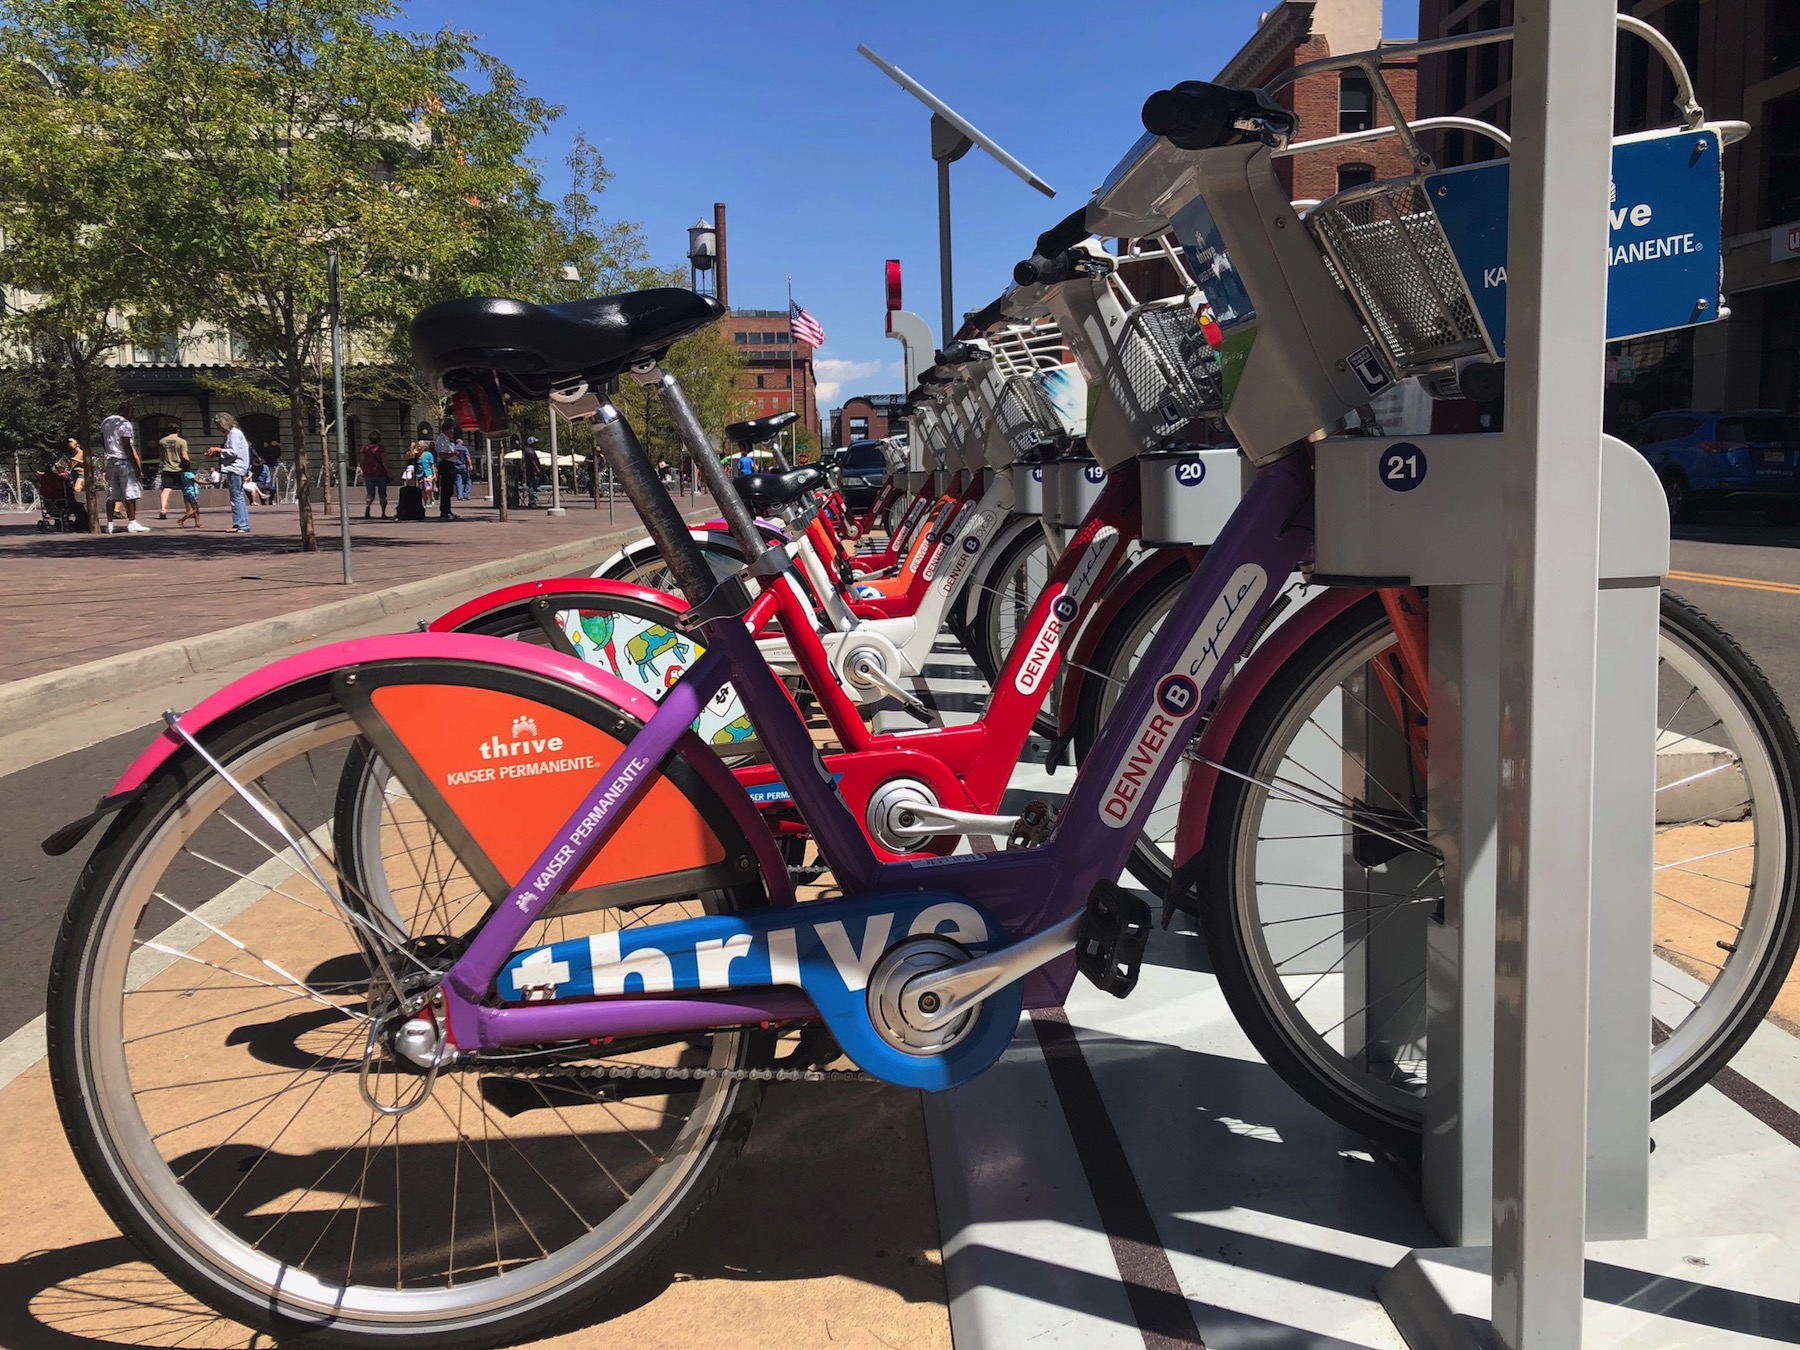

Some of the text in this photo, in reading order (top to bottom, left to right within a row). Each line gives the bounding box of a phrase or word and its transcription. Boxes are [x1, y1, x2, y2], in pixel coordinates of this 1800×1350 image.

[1609, 233, 1695, 266] ANENTE
[1087, 466, 1104, 479] 19
[1179, 462, 1202, 480] 20
[1387, 455, 1417, 480] 21
[911, 542, 931, 571] DENVER
[925, 544, 947, 578] DENVER
[943, 553, 970, 593] DENVER
[1020, 620, 1063, 688] DENVER
[1104, 714, 1174, 821] DENVER
[1189, 575, 1257, 676] cycle
[480, 736, 564, 760] thrive
[447, 768, 496, 786] KAISER
[532, 844, 576, 892] KAISER
